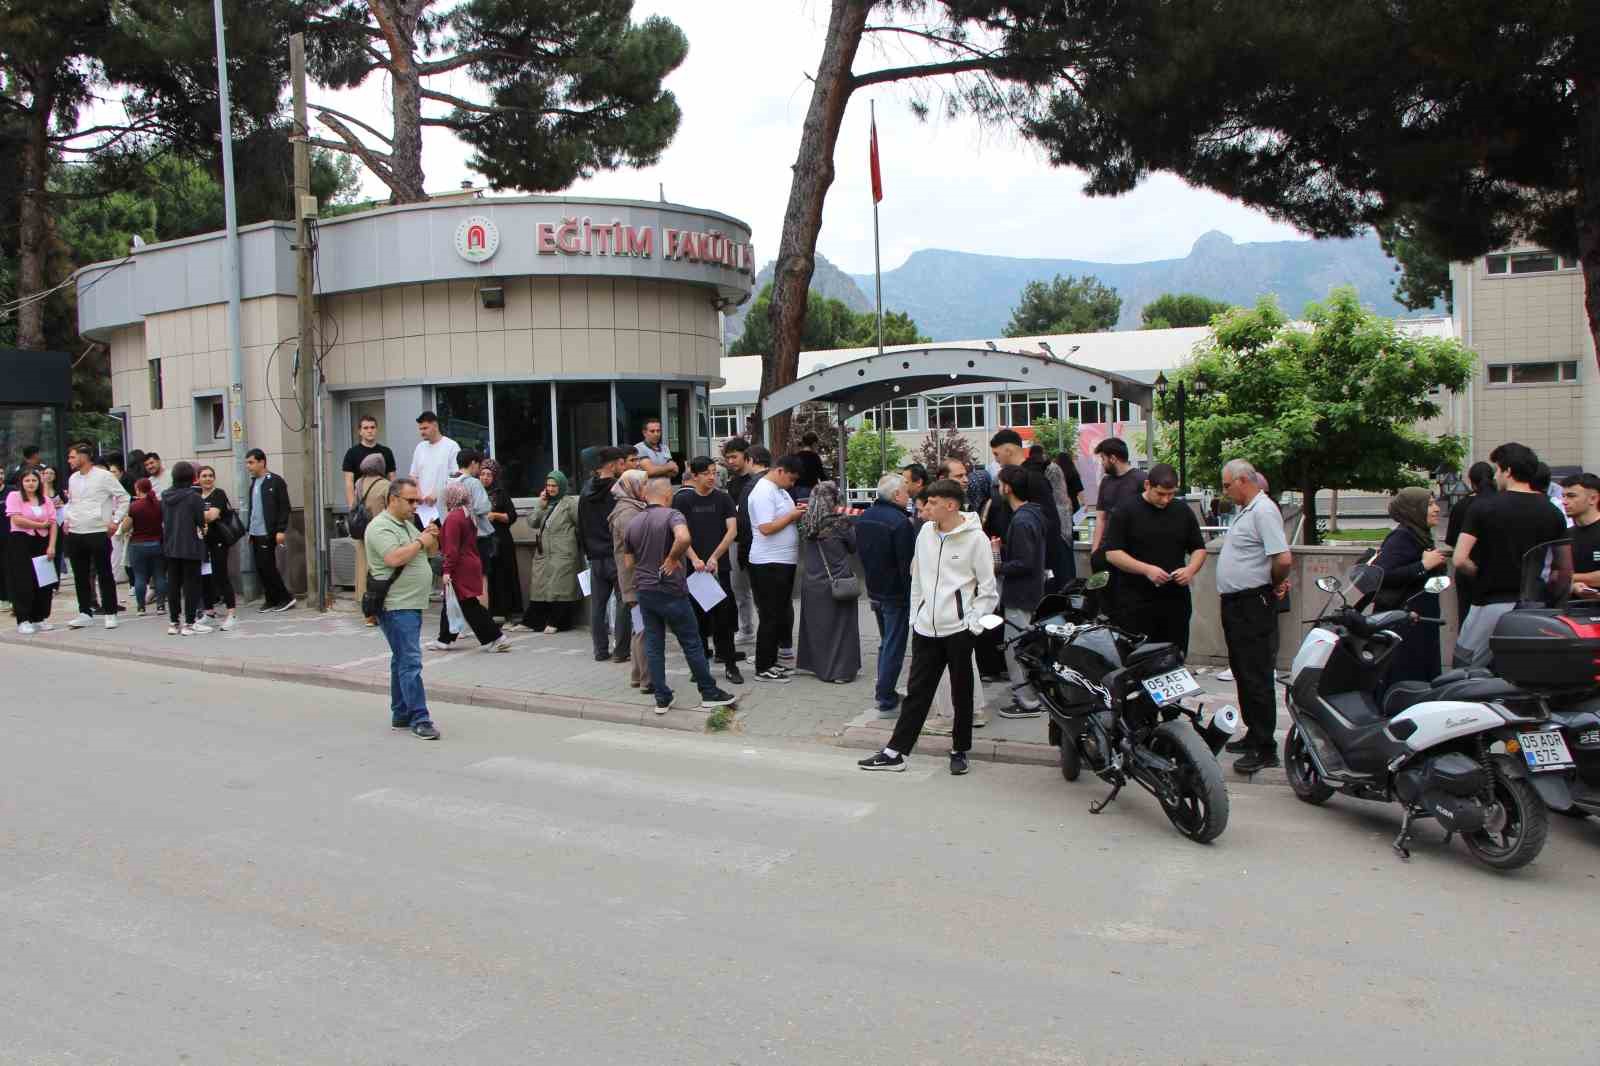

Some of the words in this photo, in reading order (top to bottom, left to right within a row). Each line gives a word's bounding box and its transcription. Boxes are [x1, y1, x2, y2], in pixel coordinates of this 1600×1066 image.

[536, 216, 652, 258] EĞİTİM
[1147, 678, 1164, 690] 05
[1165, 670, 1188, 683] AET
[1163, 684, 1185, 697] 219
[1522, 736, 1538, 748] 05
[1536, 749, 1560, 762] 575
